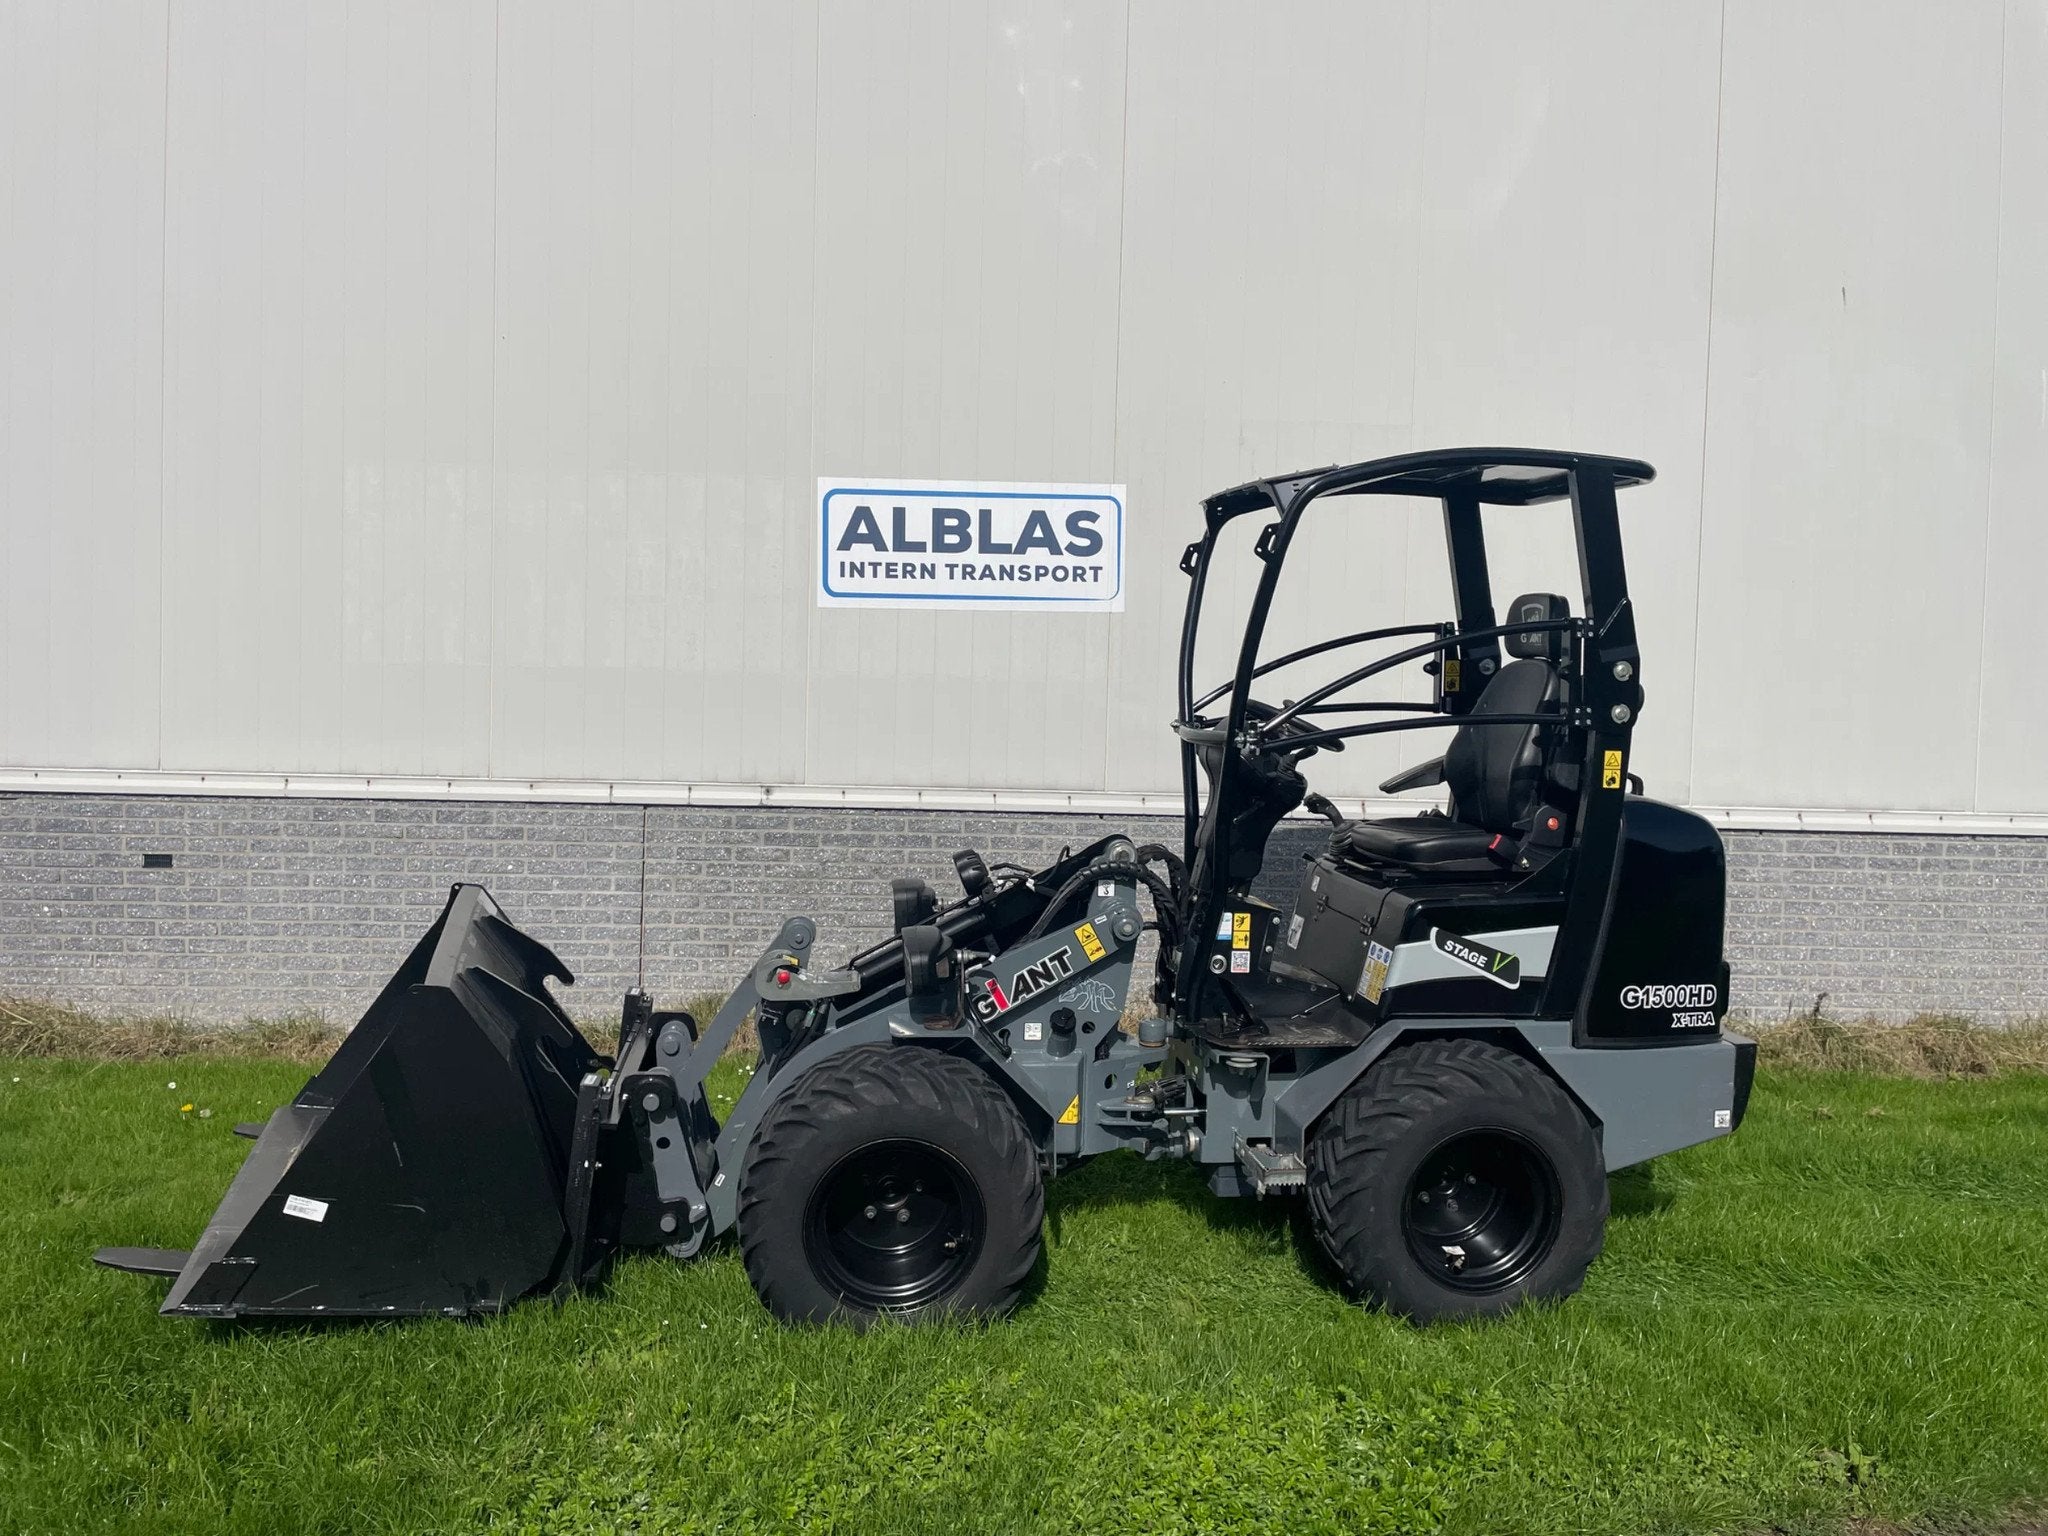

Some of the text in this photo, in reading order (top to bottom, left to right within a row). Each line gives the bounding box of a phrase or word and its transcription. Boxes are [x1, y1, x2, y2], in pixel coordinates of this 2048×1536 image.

[836, 506, 1104, 557] ALBLAS
[839, 561, 1104, 583] INTERN TRANSPORT
[1520, 633, 1543, 643] GANT
[1444, 940, 1516, 973] STAGE V
[1620, 984, 1717, 1009] G1500HD
[1671, 1011, 1715, 1028] X-TRA
